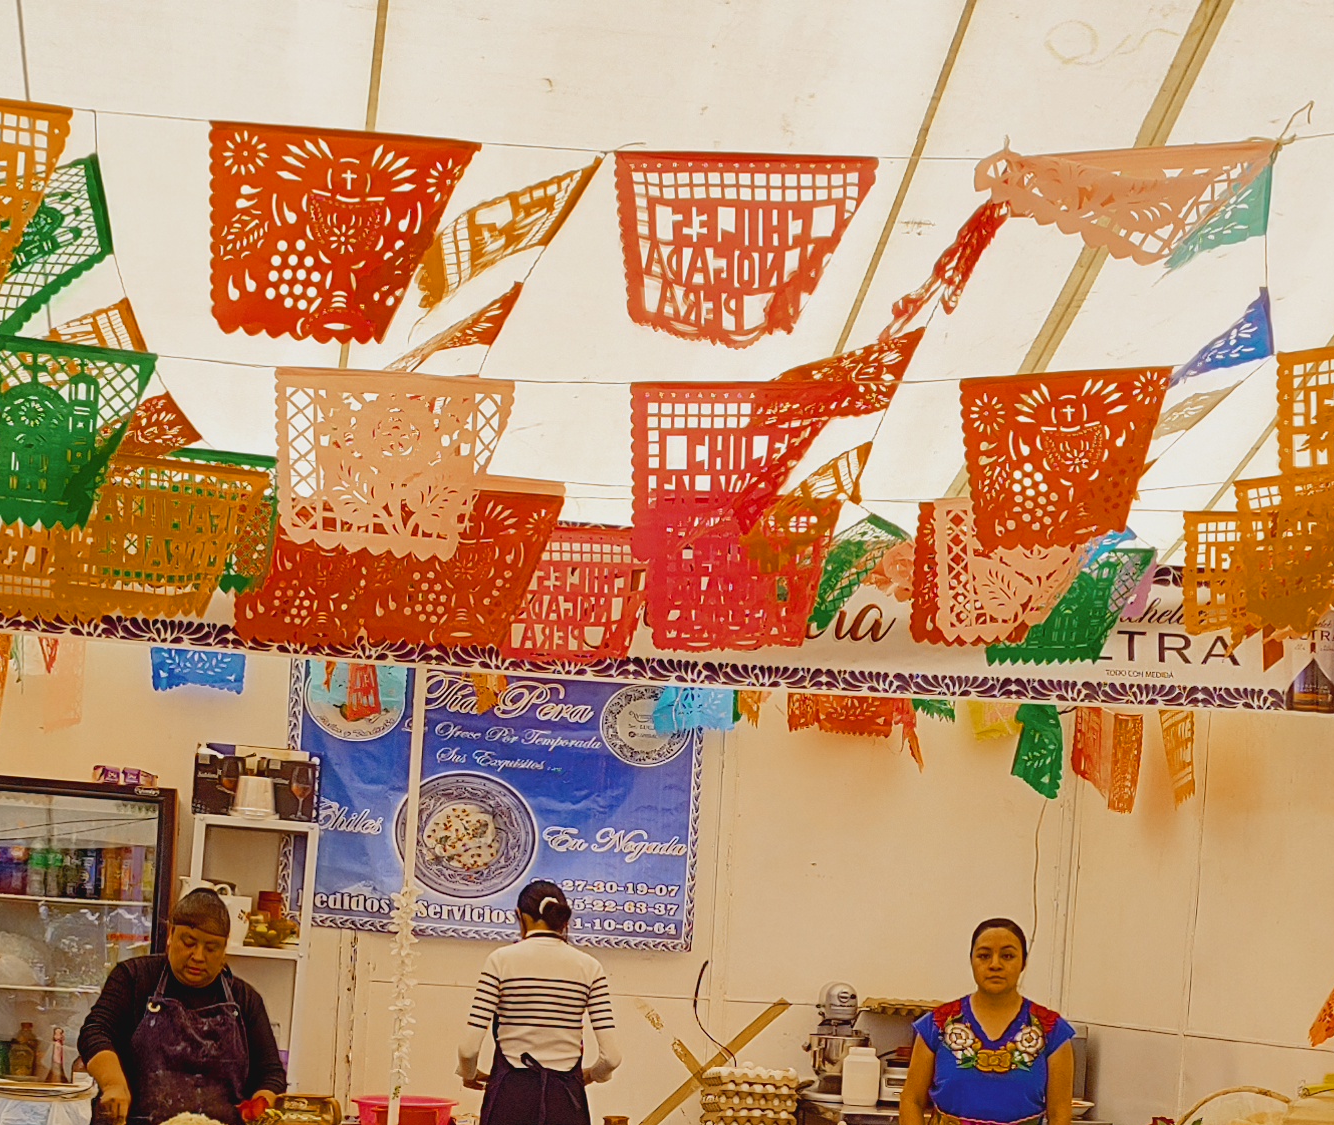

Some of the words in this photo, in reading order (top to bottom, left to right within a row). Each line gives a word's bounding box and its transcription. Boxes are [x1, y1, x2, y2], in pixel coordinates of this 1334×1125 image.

[1107, 630, 1241, 667] TRA
[493, 680, 595, 724] Pera
[436, 745, 468, 764] Sus
[485, 726, 519, 744] Por
[520, 728, 604, 752] Temporada
[317, 795, 385, 836] Chiles
[542, 825, 589, 853] En
[590, 827, 688, 864] Nogada
[531, 877, 681, 898] -27-30-19-07
[297, 889, 392, 916] edidos
[415, 899, 517, 926] Servicios
